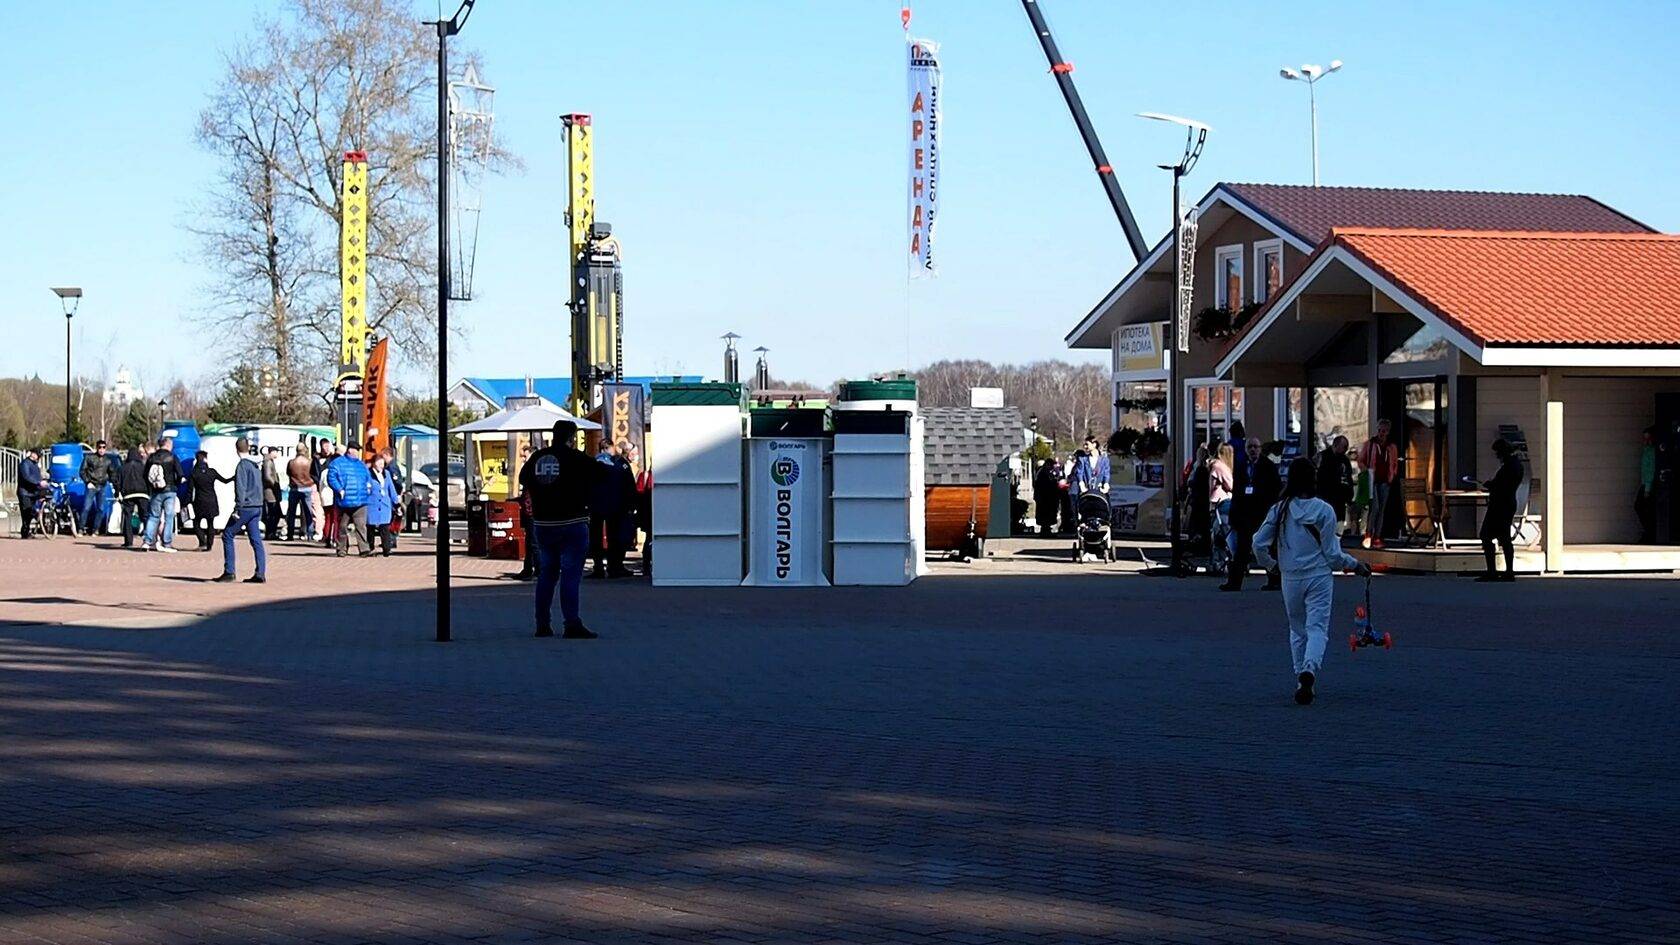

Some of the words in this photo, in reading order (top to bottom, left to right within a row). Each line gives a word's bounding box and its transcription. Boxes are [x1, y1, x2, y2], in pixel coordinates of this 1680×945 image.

[911, 92, 924, 255] АРЕНДА
[1120, 326, 1150, 339] ИПОТЕКА
[1120, 342, 1129, 353] НА
[1131, 340, 1152, 354] ДОМА
[534, 462, 560, 476] LIFE
[776, 489, 791, 579] ВОЛГАРЬ
